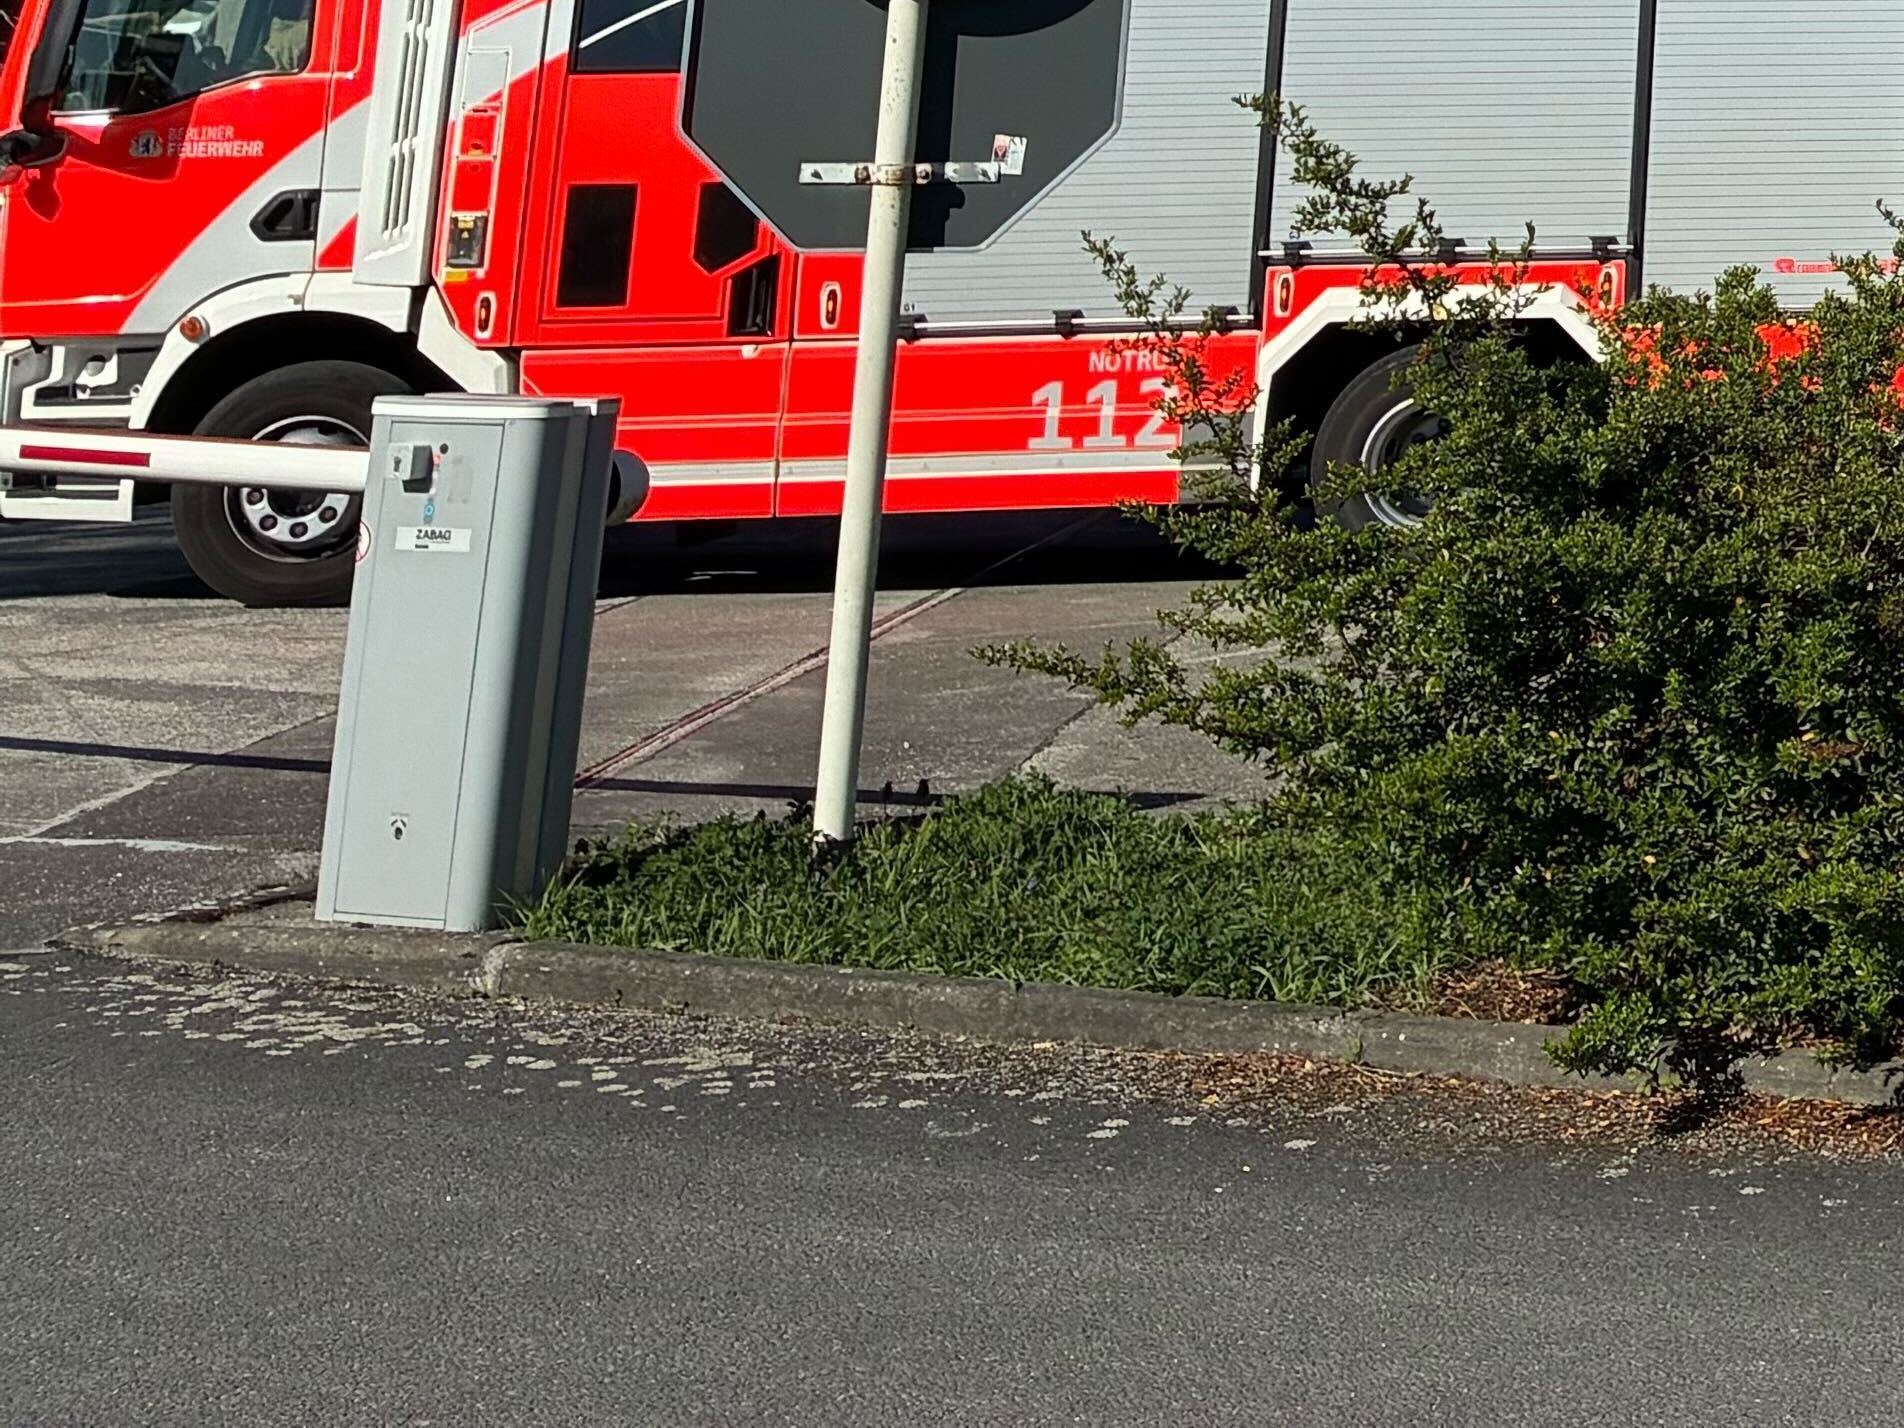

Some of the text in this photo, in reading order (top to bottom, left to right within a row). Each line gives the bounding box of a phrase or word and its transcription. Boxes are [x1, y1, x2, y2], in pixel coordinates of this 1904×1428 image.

[167, 125, 235, 142] BERLINER
[166, 140, 265, 158] FEUERWEHR
[1027, 377, 1179, 450] 112
